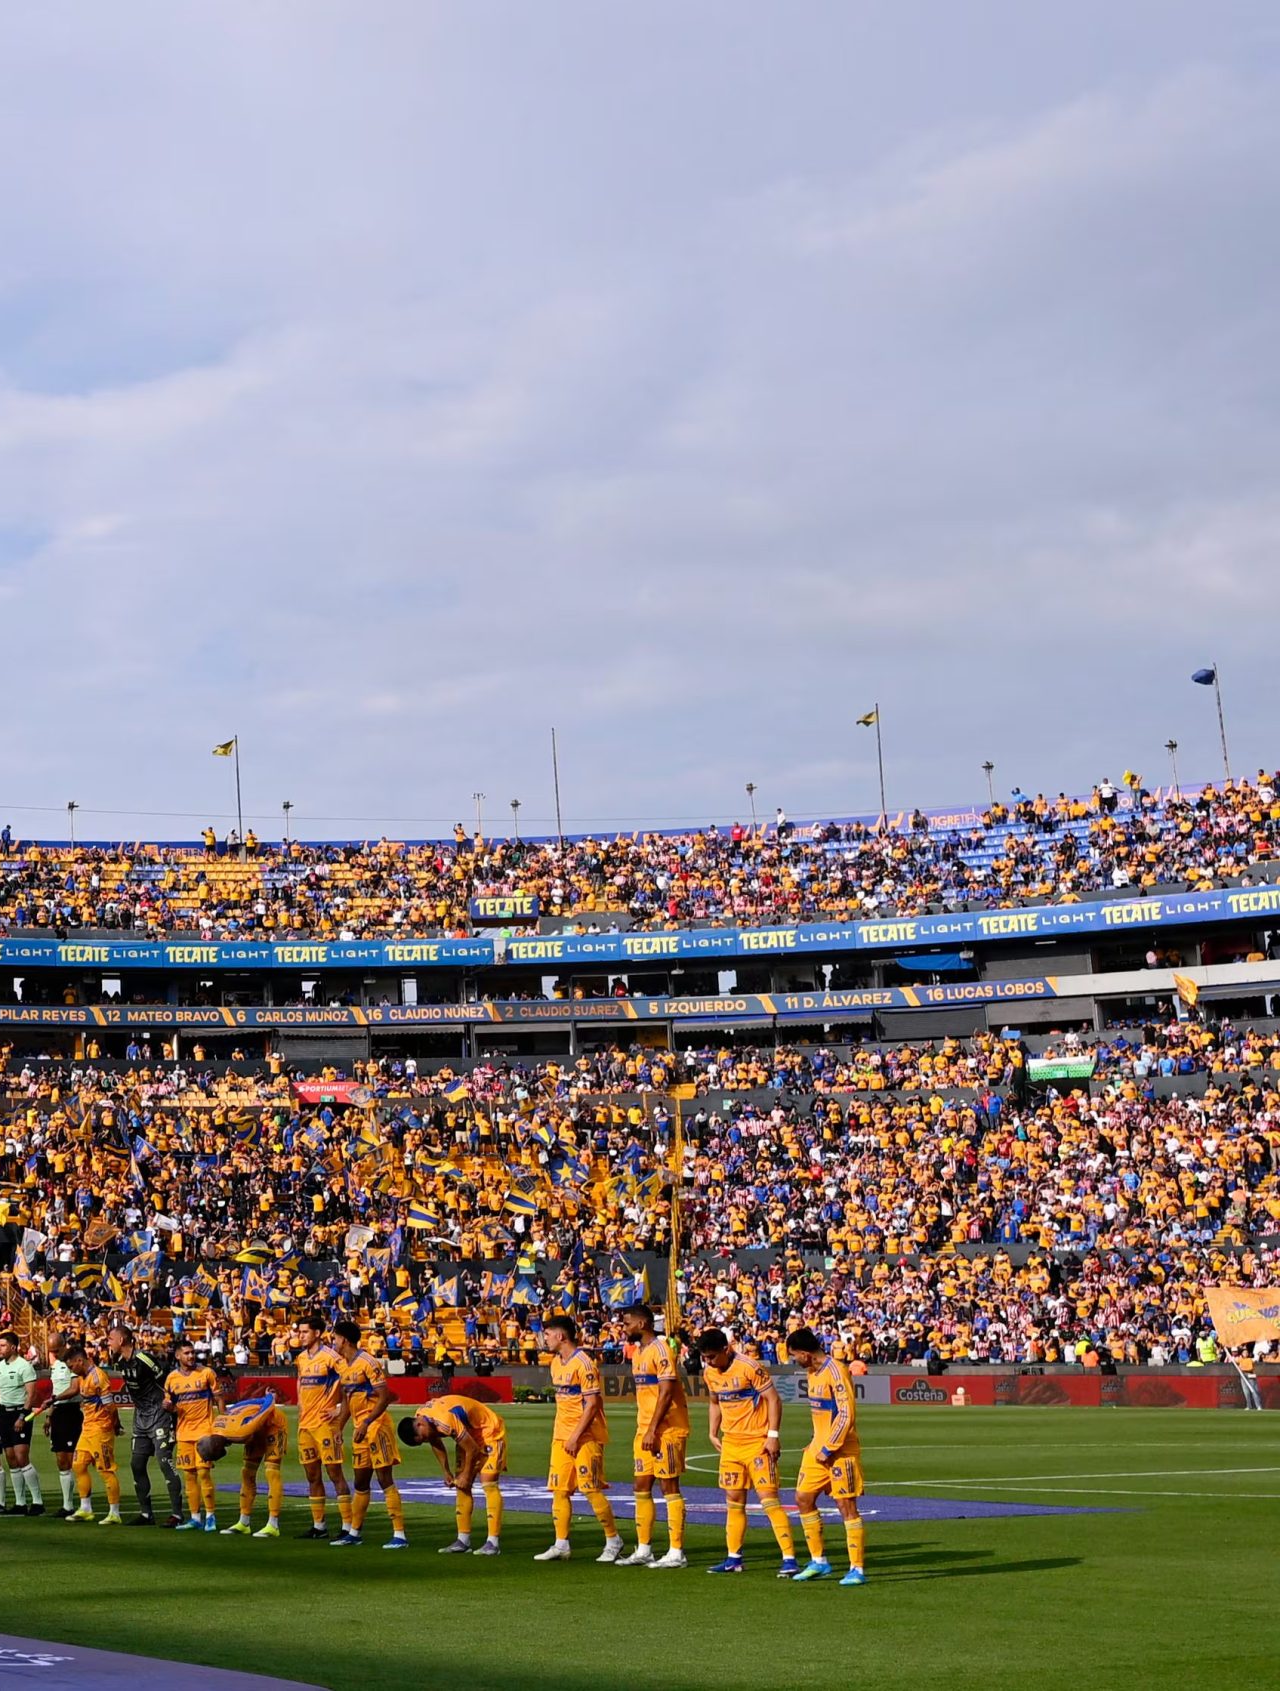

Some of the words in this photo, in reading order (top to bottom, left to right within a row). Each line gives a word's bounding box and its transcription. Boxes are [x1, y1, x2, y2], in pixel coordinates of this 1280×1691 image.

[475, 896, 533, 917] TECATE
[1229, 890, 1280, 912] TECAT
[1103, 902, 1161, 923] TECATE
[1165, 901, 1221, 914] LIGHT
[979, 914, 1037, 933] TECATE
[1042, 913, 1096, 926] LIGHT
[740, 931, 795, 948] TECATE
[800, 931, 851, 941] LIGHT
[860, 924, 915, 942] TECATE
[921, 923, 972, 934] LIGHT
[386, 945, 437, 960] TECATE
[442, 947, 491, 956] LIGHT
[510, 941, 563, 958] TECATE
[567, 943, 616, 953] LIGHT
[624, 937, 677, 954] TECATE
[683, 938, 733, 948] LIGHT
[59, 946, 108, 961] TECATE
[113, 950, 159, 958] LIGHT
[167, 947, 217, 962] TECATE
[222, 950, 269, 959] LIGHT
[275, 947, 327, 962] TECATE
[331, 950, 379, 958] LIGHT
[926, 988, 943, 1000] 16
[947, 986, 993, 999] LUCAS
[996, 982, 1044, 995] LOBOS
[649, 1002, 657, 1013] 5
[664, 1000, 746, 1013] IZQUIERDO
[785, 997, 798, 1008] 11
[803, 996, 816, 1008] D.
[822, 992, 891, 1007] ÁLVAREZ
[0, 1009, 36, 1021] PILAR
[43, 1010, 86, 1021] REYES
[107, 1010, 121, 1021] 12
[128, 1010, 171, 1021] MATEO
[175, 1010, 219, 1022] BRAVO
[237, 1010, 246, 1021] 6
[256, 1010, 301, 1022] CARLOS
[367, 1009, 382, 1019] 16
[389, 1008, 440, 1019] CLAUDIO
[443, 1004, 484, 1019] NÚÑEZ
[505, 1007, 513, 1018] 2
[520, 1006, 570, 1017] CLAUDIO
[916, 1381, 927, 1390] La
[899, 1389, 945, 1402] Costeña
[303, 1448, 317, 1460] 33
[724, 1472, 739, 1486] 27
